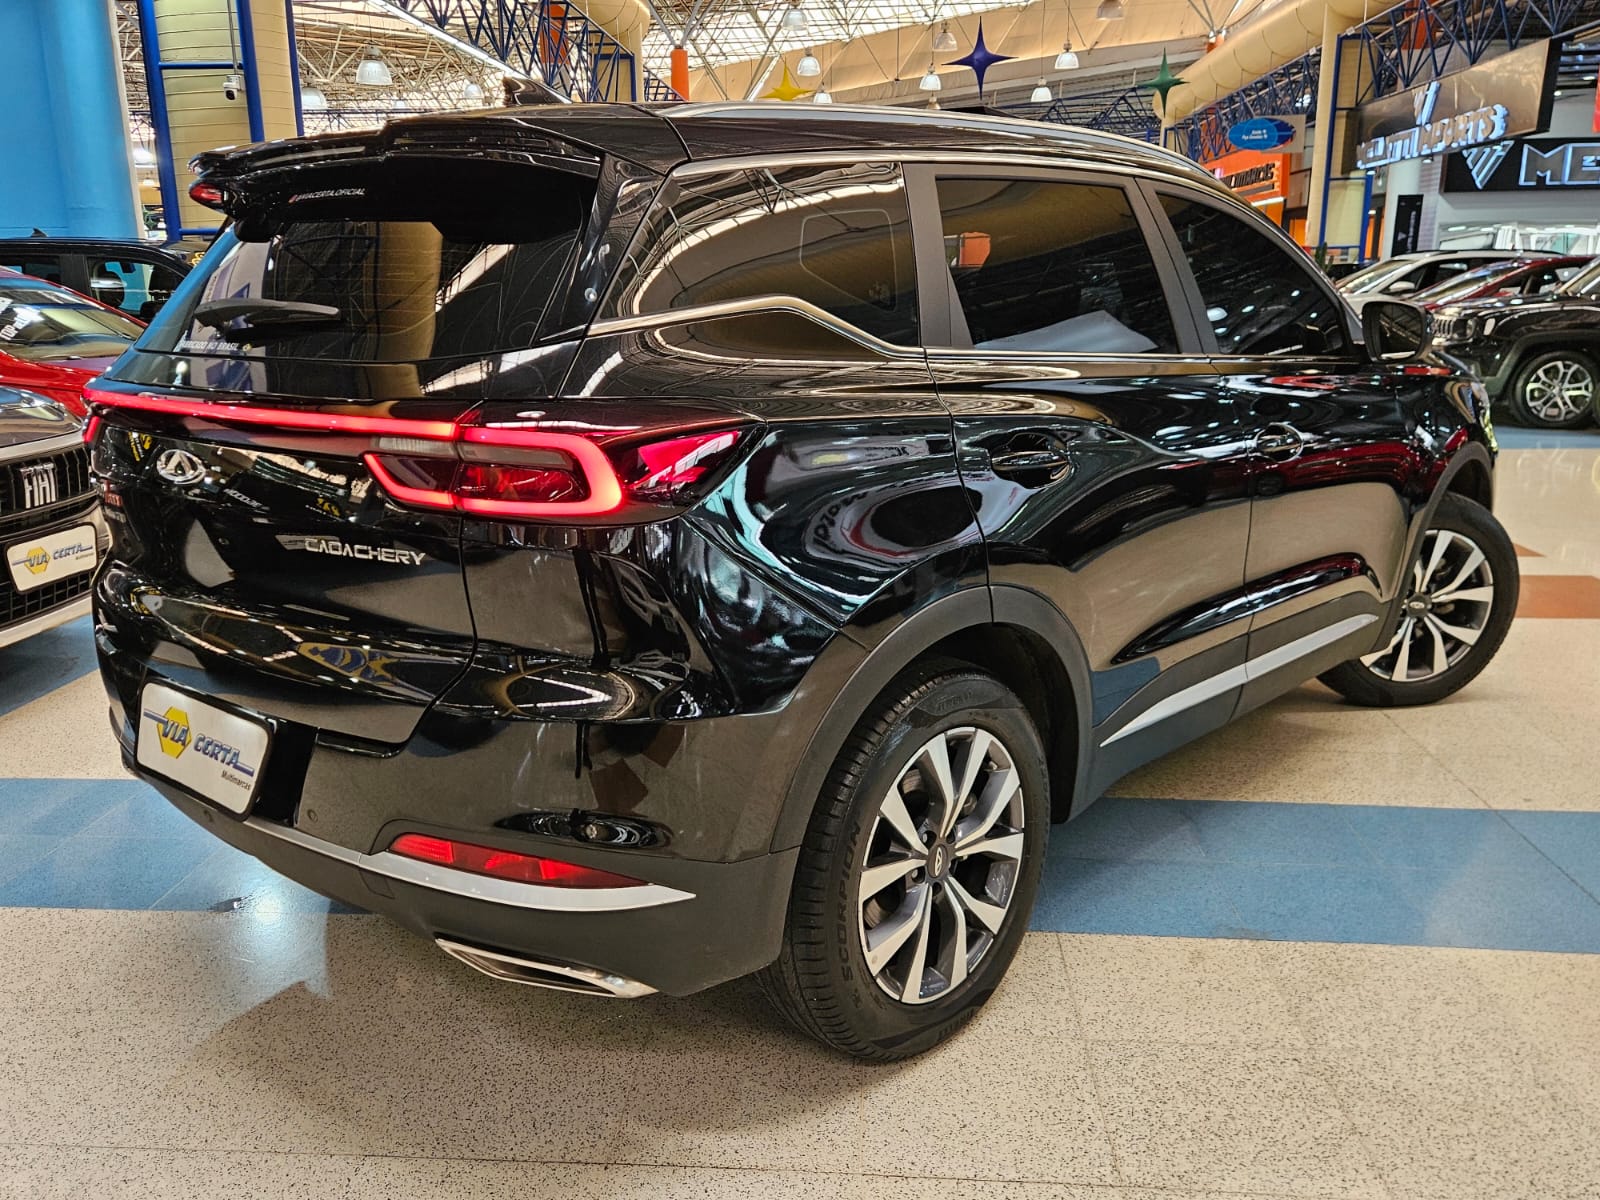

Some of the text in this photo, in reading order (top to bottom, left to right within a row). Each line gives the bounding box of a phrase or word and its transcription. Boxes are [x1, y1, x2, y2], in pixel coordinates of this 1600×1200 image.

[20, 462, 57, 509] FIAT
[28, 553, 49, 568] VIA
[52, 544, 83, 560] CERTA
[161, 719, 241, 767] VIA CERTA
[221, 769, 251, 791] Multimarcas
[837, 821, 861, 982] SCORPION
